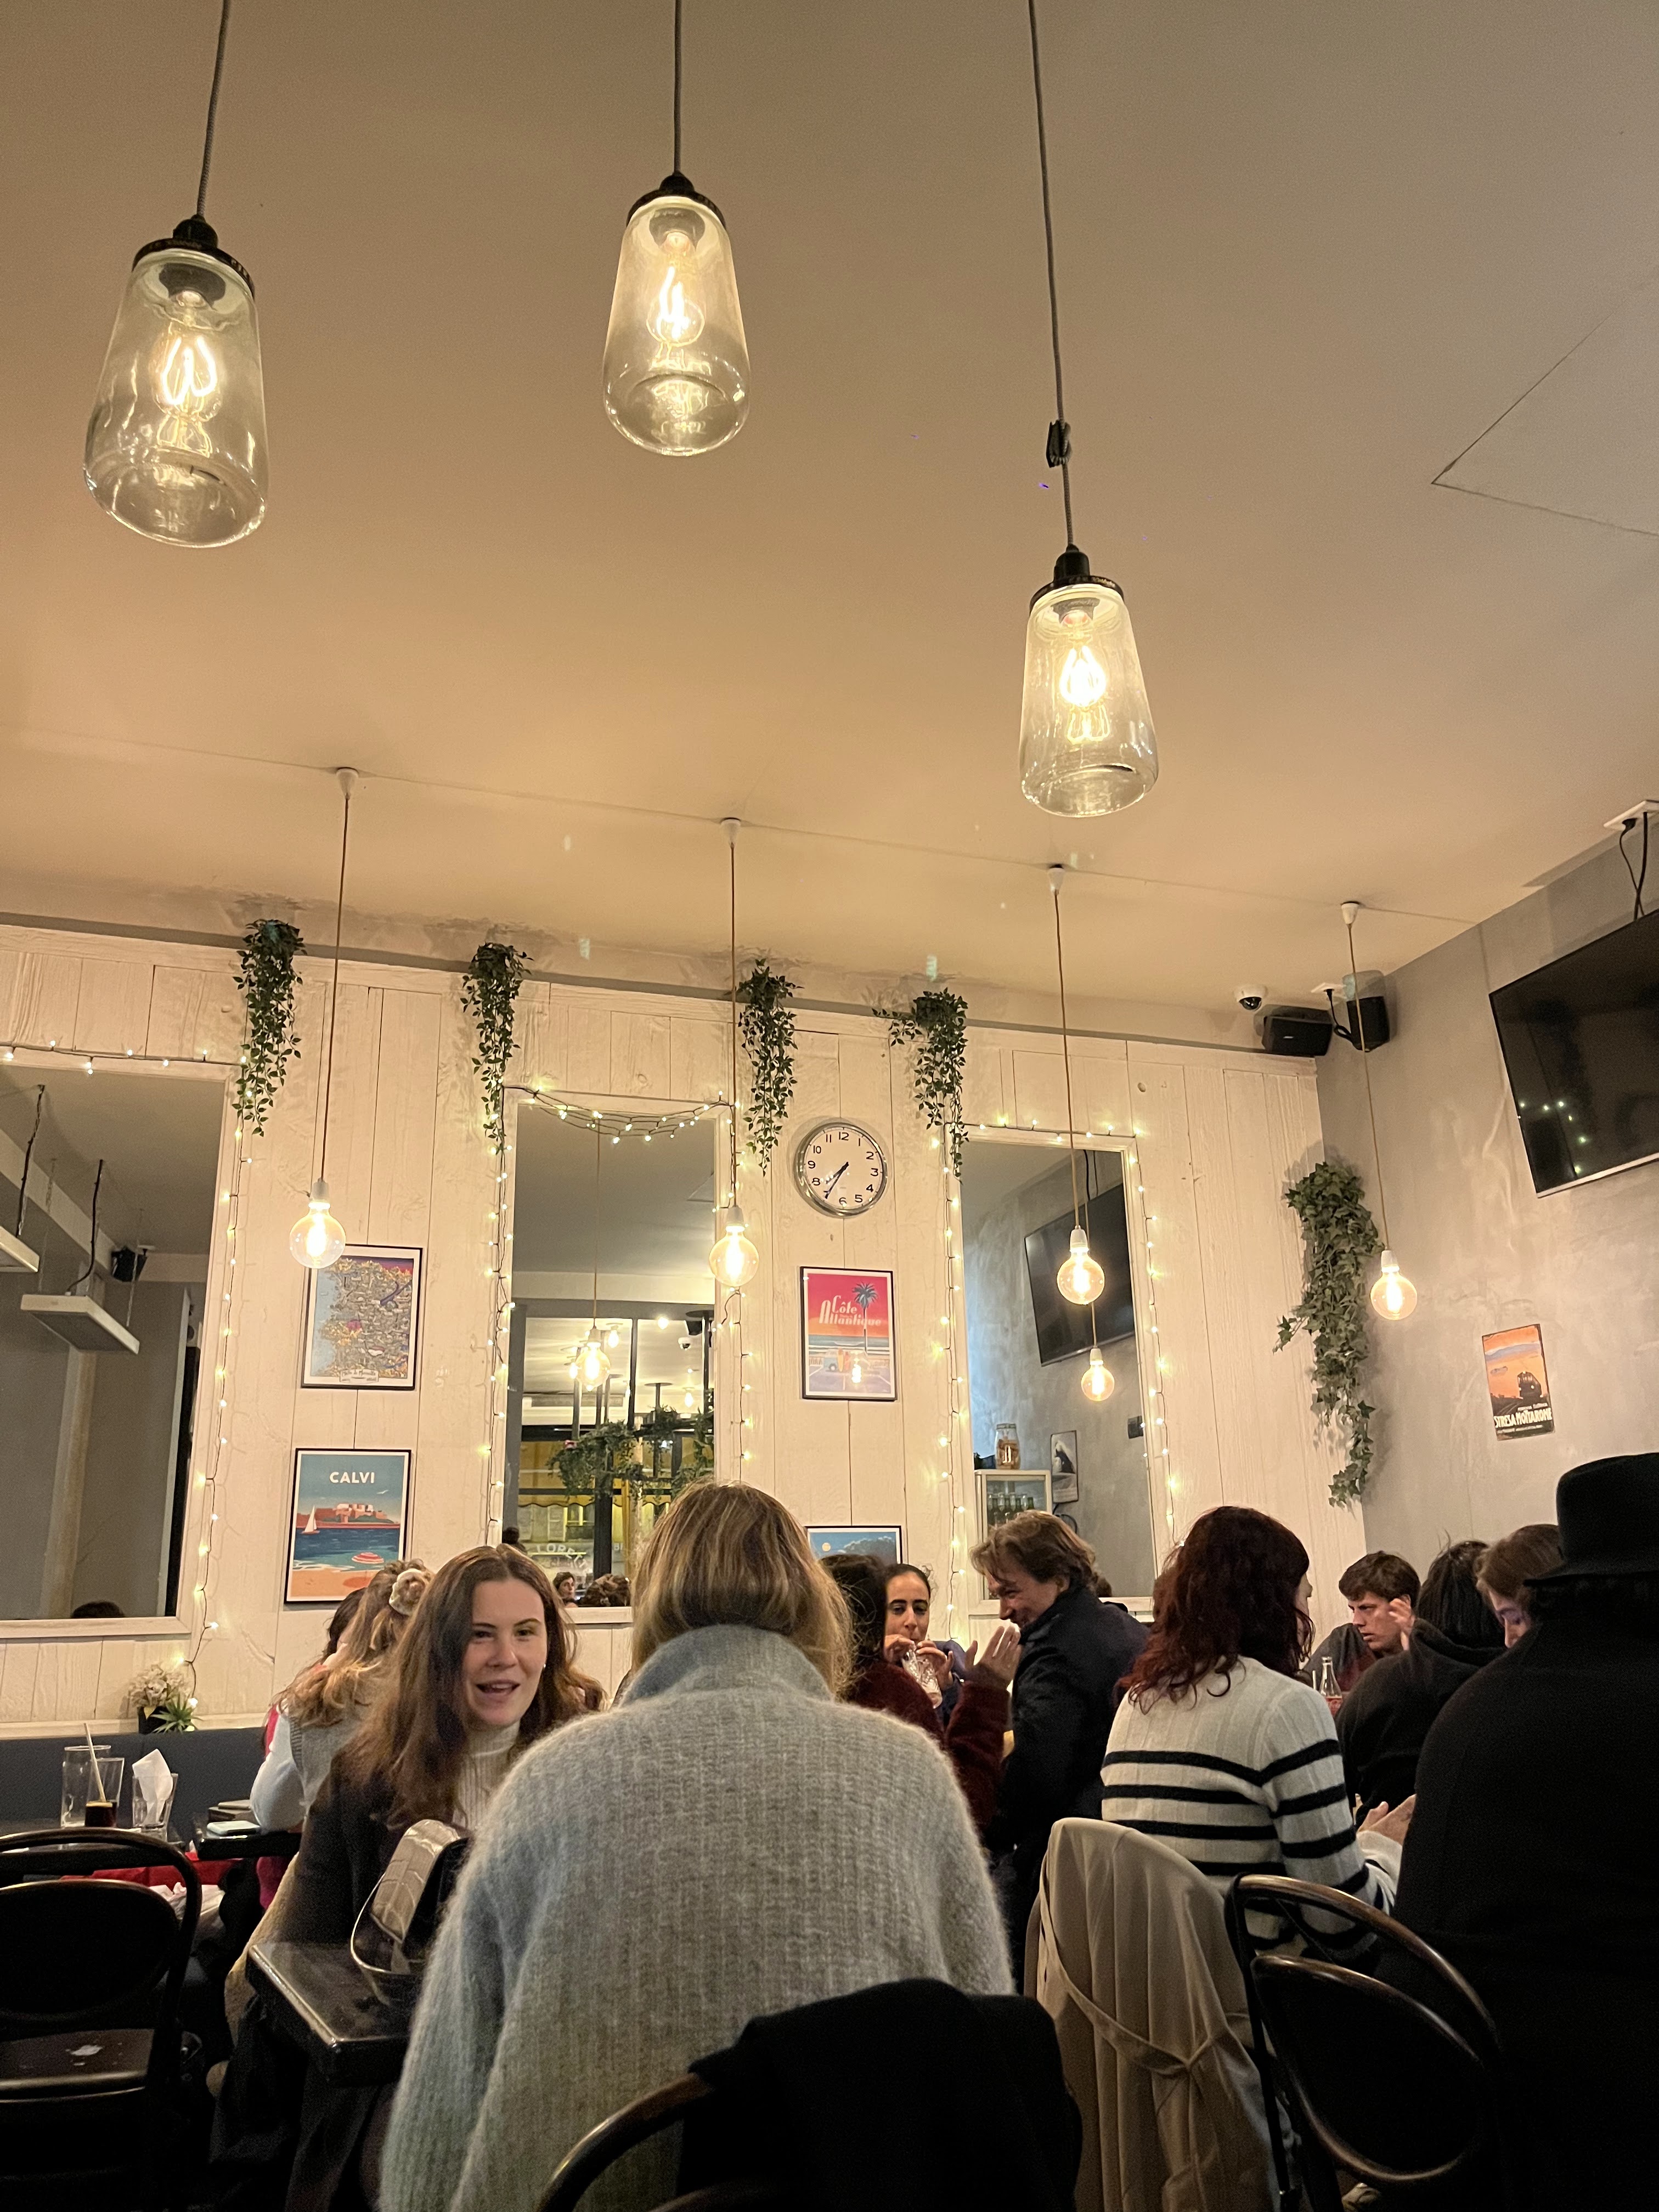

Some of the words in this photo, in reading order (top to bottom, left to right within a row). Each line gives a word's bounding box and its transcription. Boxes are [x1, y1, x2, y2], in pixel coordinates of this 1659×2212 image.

[825, 1134, 832, 1143] 11
[838, 1131, 849, 1141] 12
[857, 1138, 861, 1147] 1
[813, 1146, 822, 1154] 10
[866, 1152, 874, 1160] 2
[808, 1160, 816, 1169] 9
[870, 1168, 879, 1177] 3
[811, 1177, 821, 1186] 8
[866, 1184, 874, 1192] 4
[838, 1197, 847, 1207] 6
[854, 1194, 863, 1203] 5
[832, 1295, 857, 1314] Côte
[819, 1300, 882, 1326] Atlantique
[330, 1471, 375, 1483] CALVI
